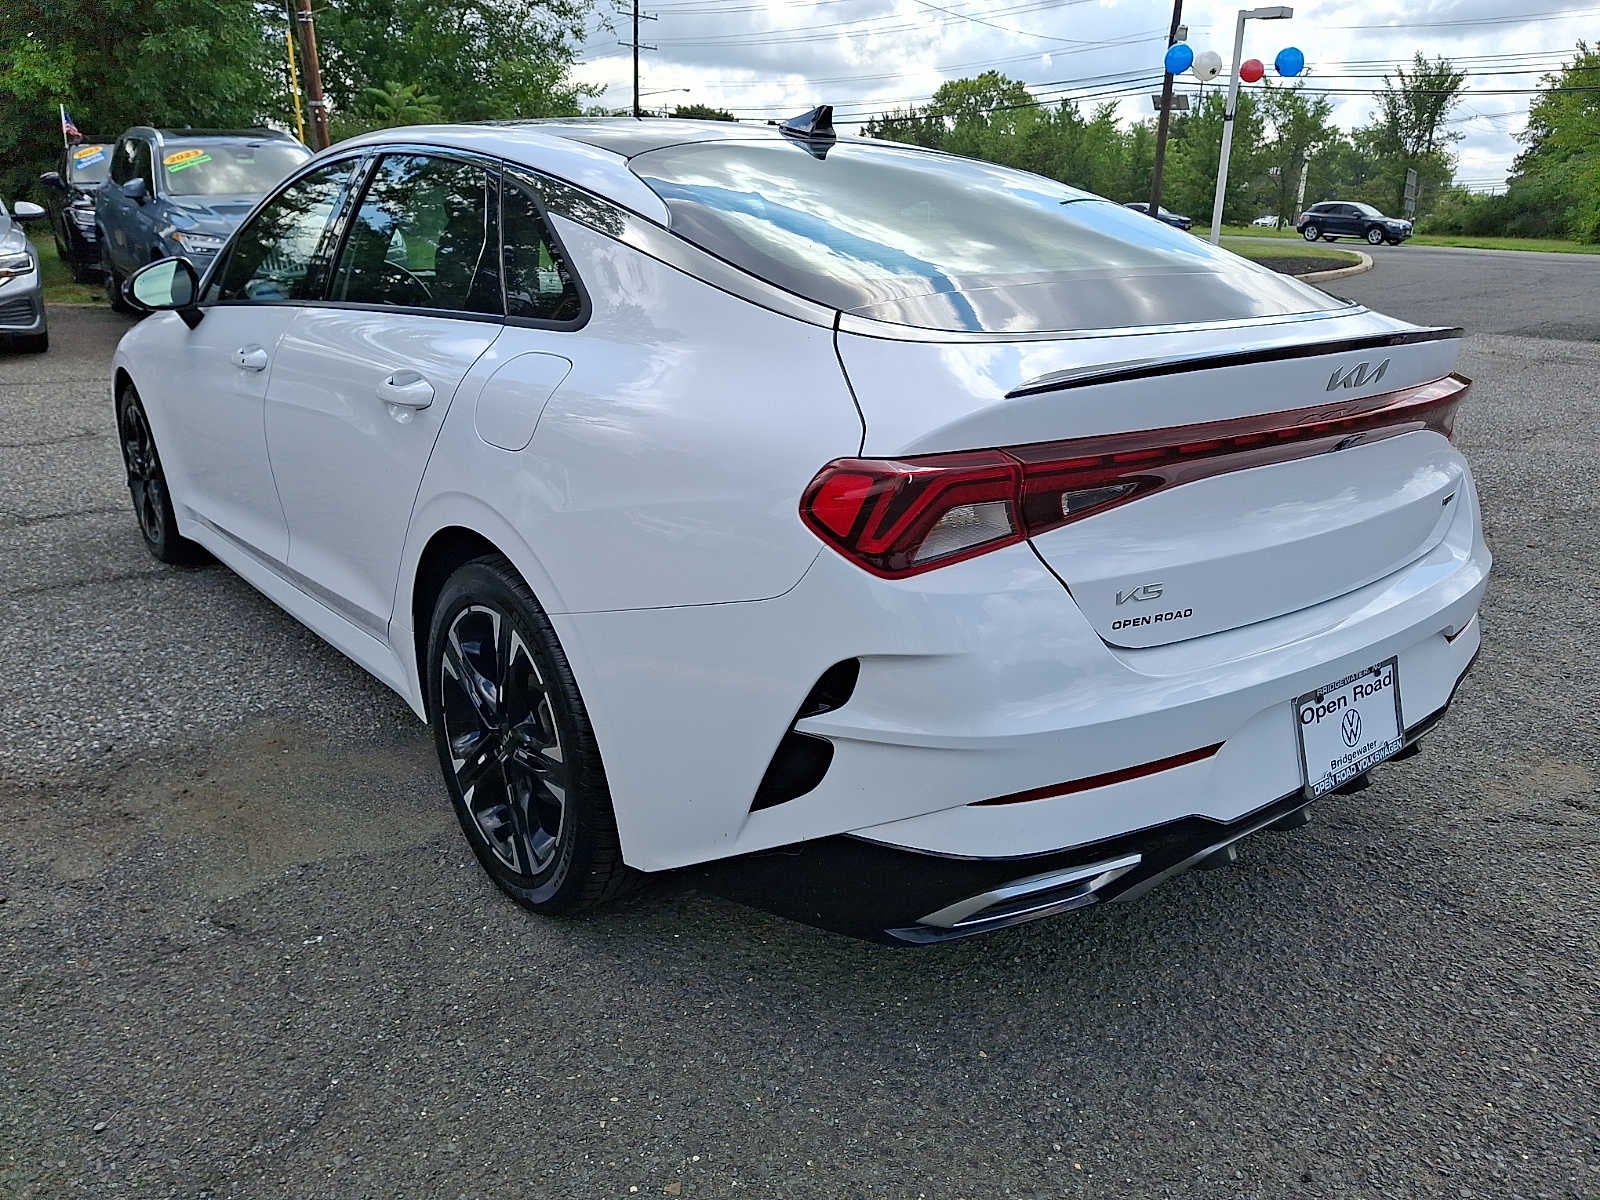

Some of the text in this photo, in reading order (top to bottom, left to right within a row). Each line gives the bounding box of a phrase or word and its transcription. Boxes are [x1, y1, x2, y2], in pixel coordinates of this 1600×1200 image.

[1326, 358, 1391, 391] KIA
[1115, 582, 1164, 606] K5
[1111, 608, 1193, 630] OPEN ROAD
[1300, 670, 1392, 725] Open Road
[1314, 738, 1403, 795] OPEN ROAD VOLKSWAGEN
[1330, 740, 1377, 771] Bridgewater
